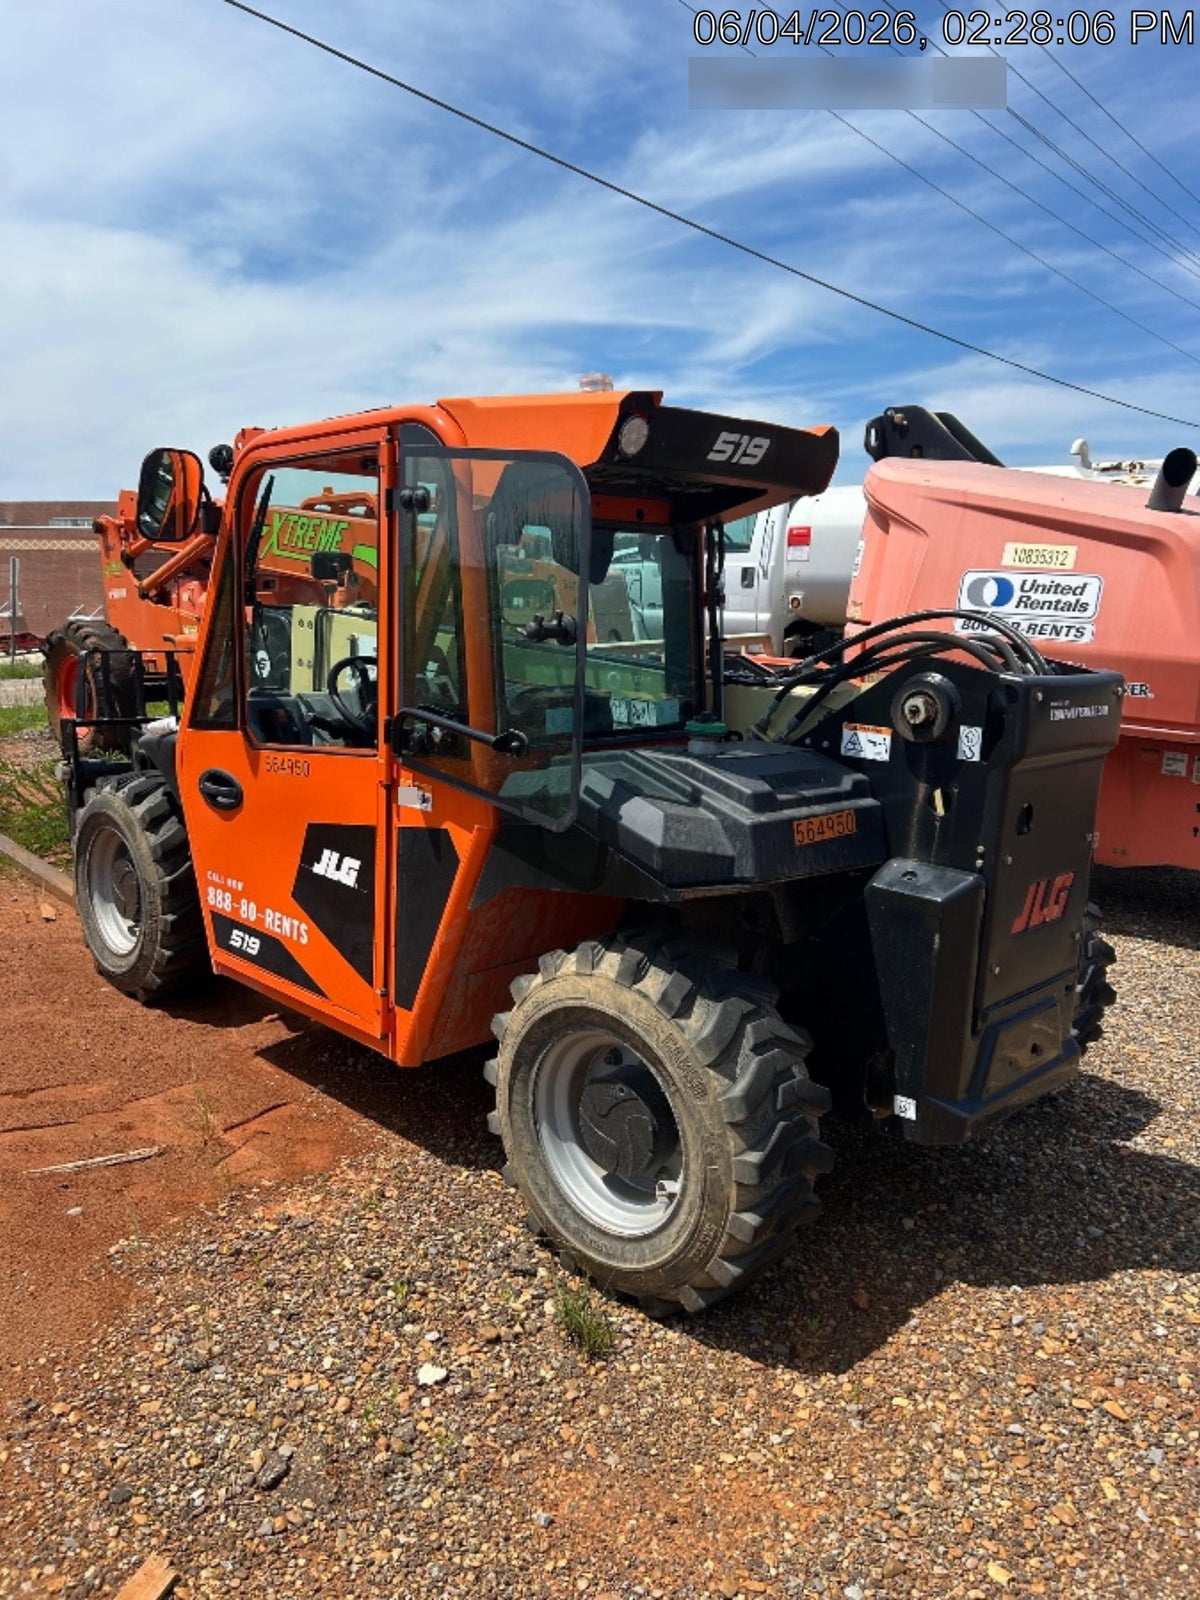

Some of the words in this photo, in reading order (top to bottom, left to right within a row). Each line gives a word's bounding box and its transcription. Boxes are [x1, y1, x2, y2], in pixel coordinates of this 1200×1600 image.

[706, 431, 771, 465] 519
[259, 511, 350, 559] XTREME
[1012, 547, 1069, 566] 10835312
[1019, 579, 1088, 596] United
[1014, 595, 1090, 613] Rentals
[265, 756, 310, 777] 564950
[795, 812, 856, 844] 564950
[312, 848, 362, 888] JLG
[206, 886, 309, 945] 888-80-RENTS
[1010, 871, 1074, 934] JLG
[228, 929, 261, 956] 519
